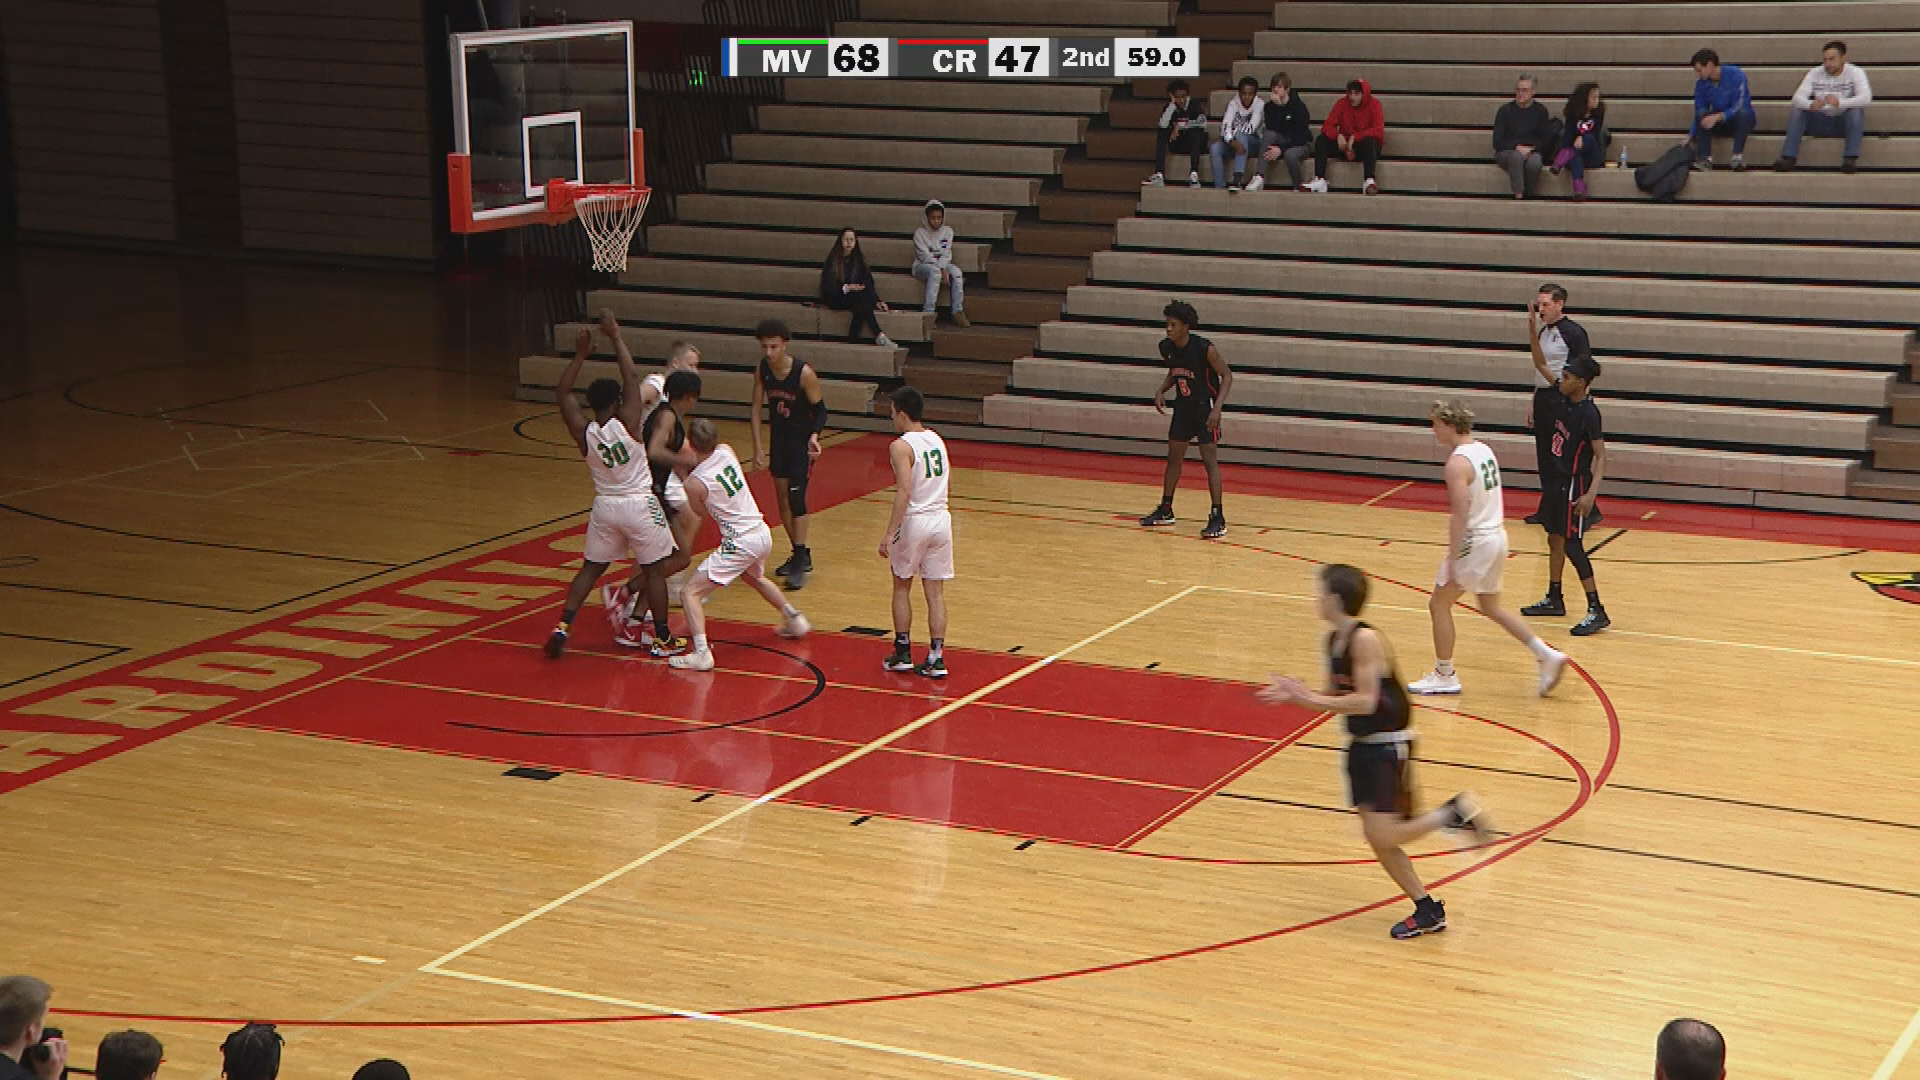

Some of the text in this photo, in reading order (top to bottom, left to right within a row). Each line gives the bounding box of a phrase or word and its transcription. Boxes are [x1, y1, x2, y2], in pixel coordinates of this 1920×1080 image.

[597, 441, 630, 468] 30
[923, 448, 943, 478] 13
[715, 464, 743, 498] 12
[1480, 458, 1498, 491] 22
